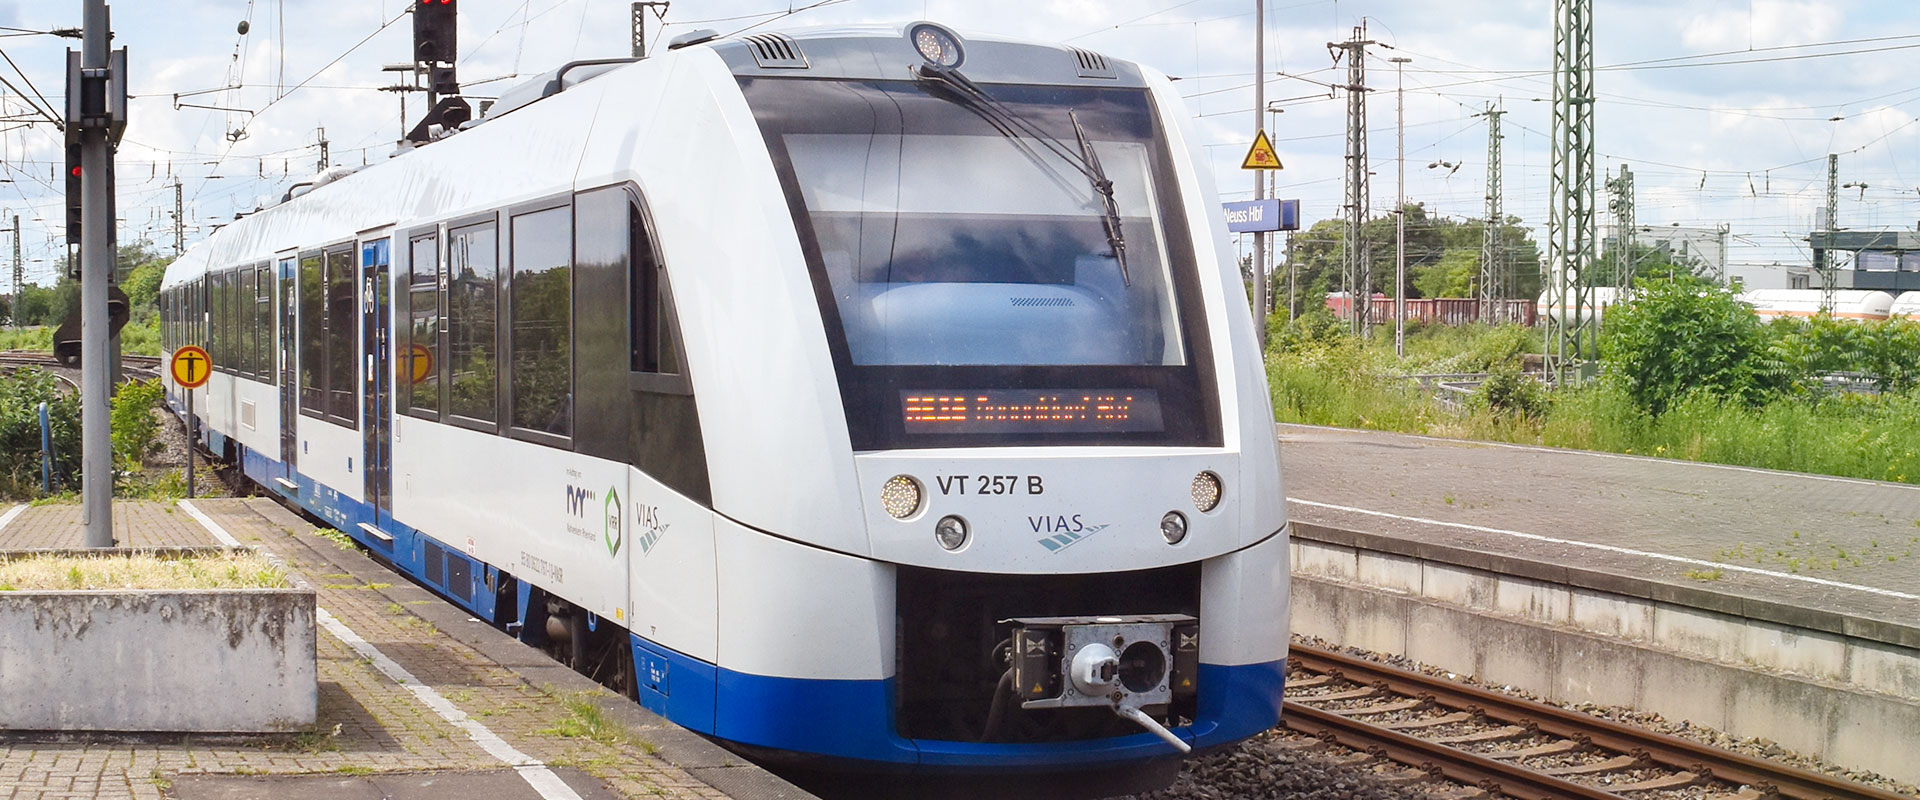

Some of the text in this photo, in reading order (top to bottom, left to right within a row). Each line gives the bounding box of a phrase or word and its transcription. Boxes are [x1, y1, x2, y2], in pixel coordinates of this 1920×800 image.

[1224, 205, 1263, 223] Neuss Hbf
[936, 475, 1044, 495] VT 257 B
[636, 502, 659, 531] VIAS
[1028, 514, 1084, 533] VIAS
